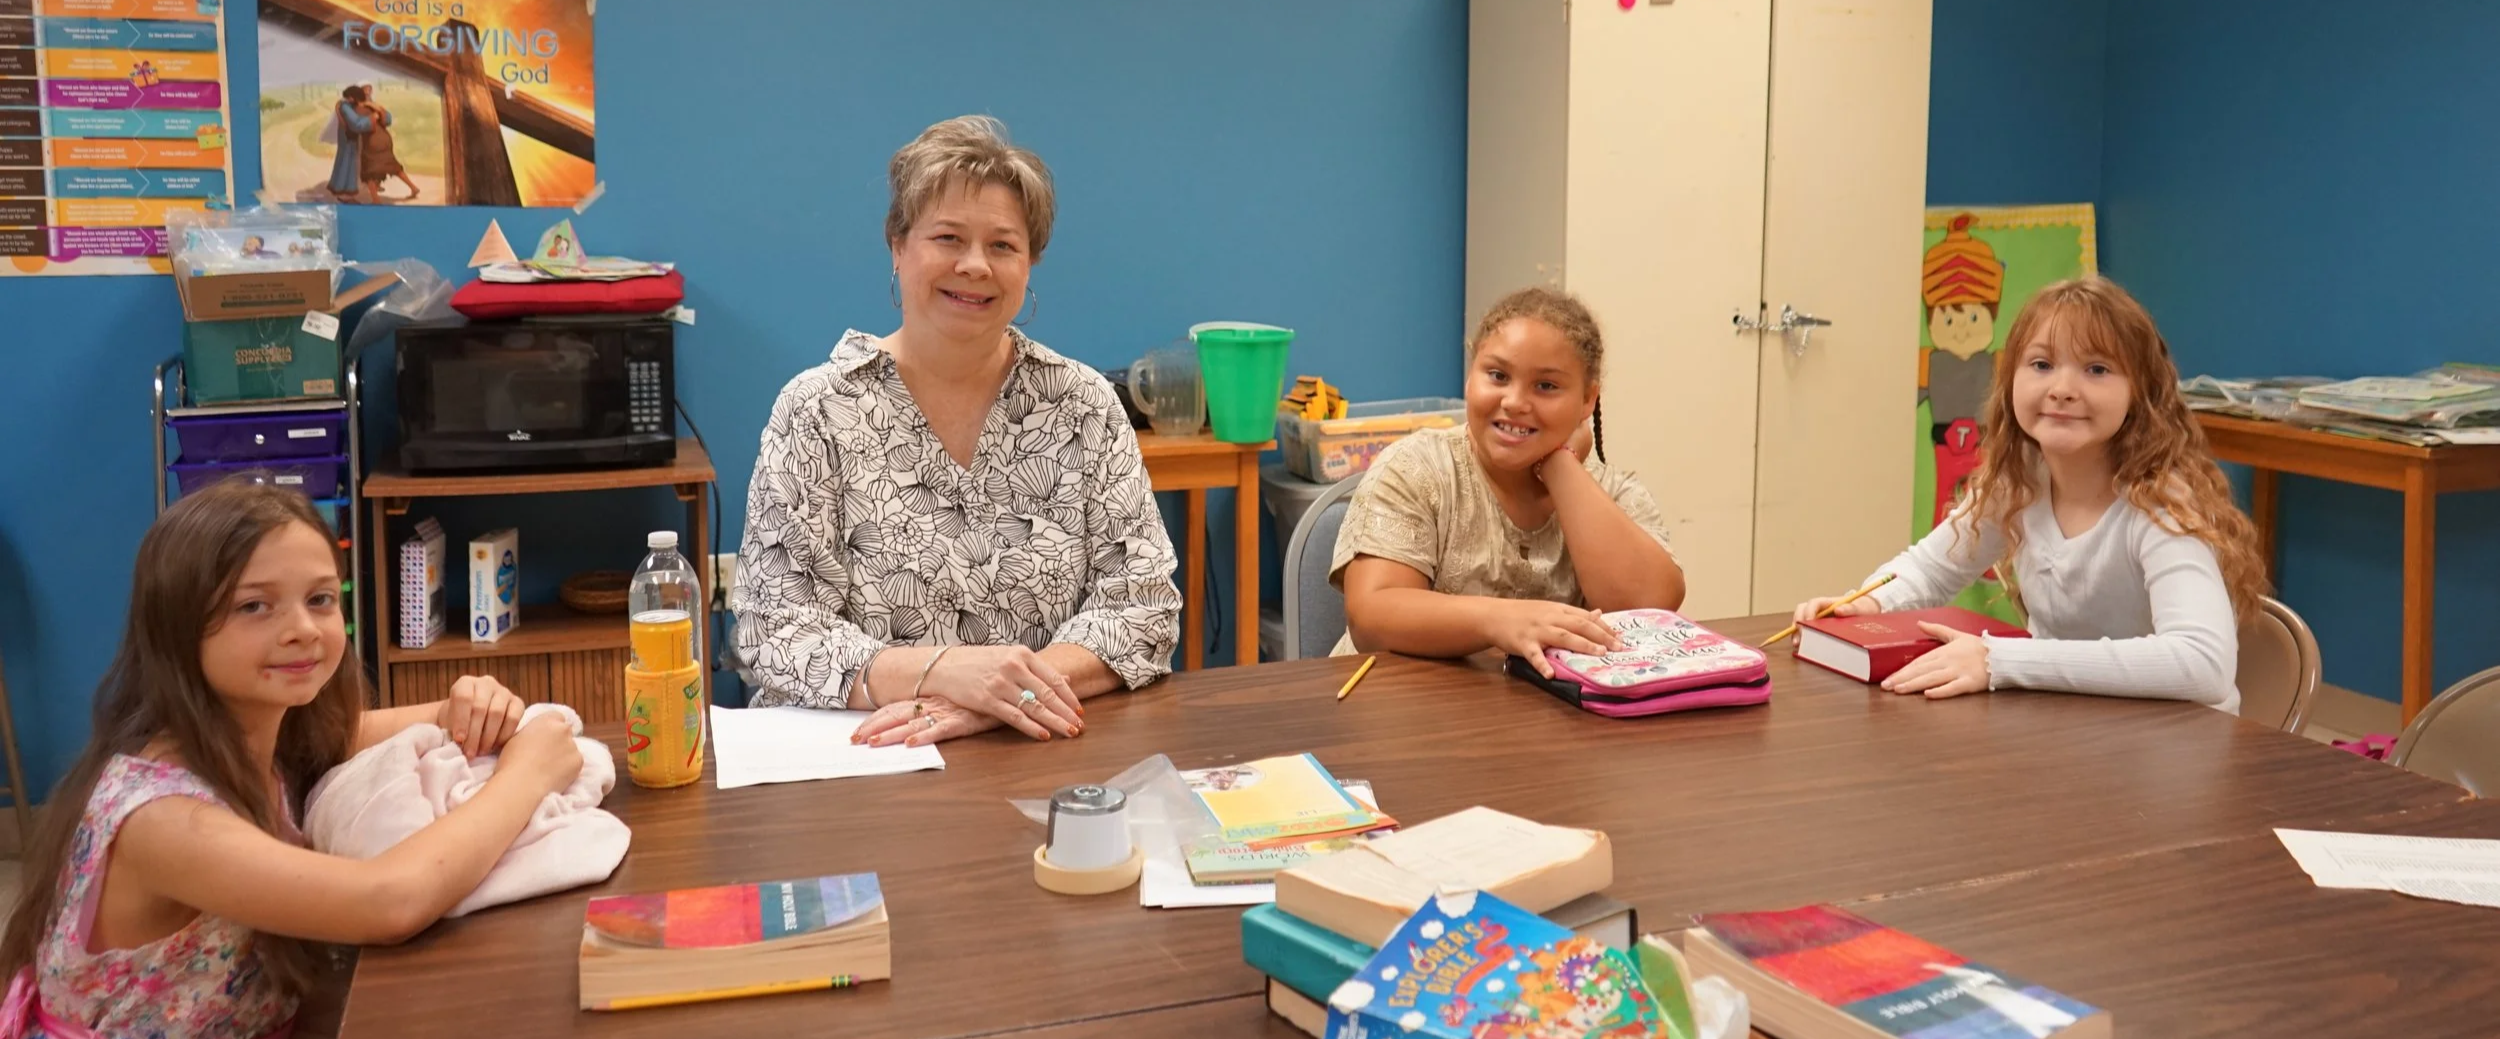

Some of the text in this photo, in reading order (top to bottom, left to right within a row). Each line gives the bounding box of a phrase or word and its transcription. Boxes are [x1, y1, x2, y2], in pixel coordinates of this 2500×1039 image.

[375, 0, 463, 17] God is a
[343, 21, 559, 58] FORGIVING
[501, 62, 549, 84] God
[235, 347, 292, 358] CONCORDIA
[1956, 427, 1970, 448] T
[474, 570, 482, 612] Premium
[1227, 851, 1311, 862] WORLD'S
[1388, 921, 1484, 1007] EXPLORER'S
[1425, 951, 1479, 995] BIBLE
[1879, 998, 1929, 1020] BIBLE
